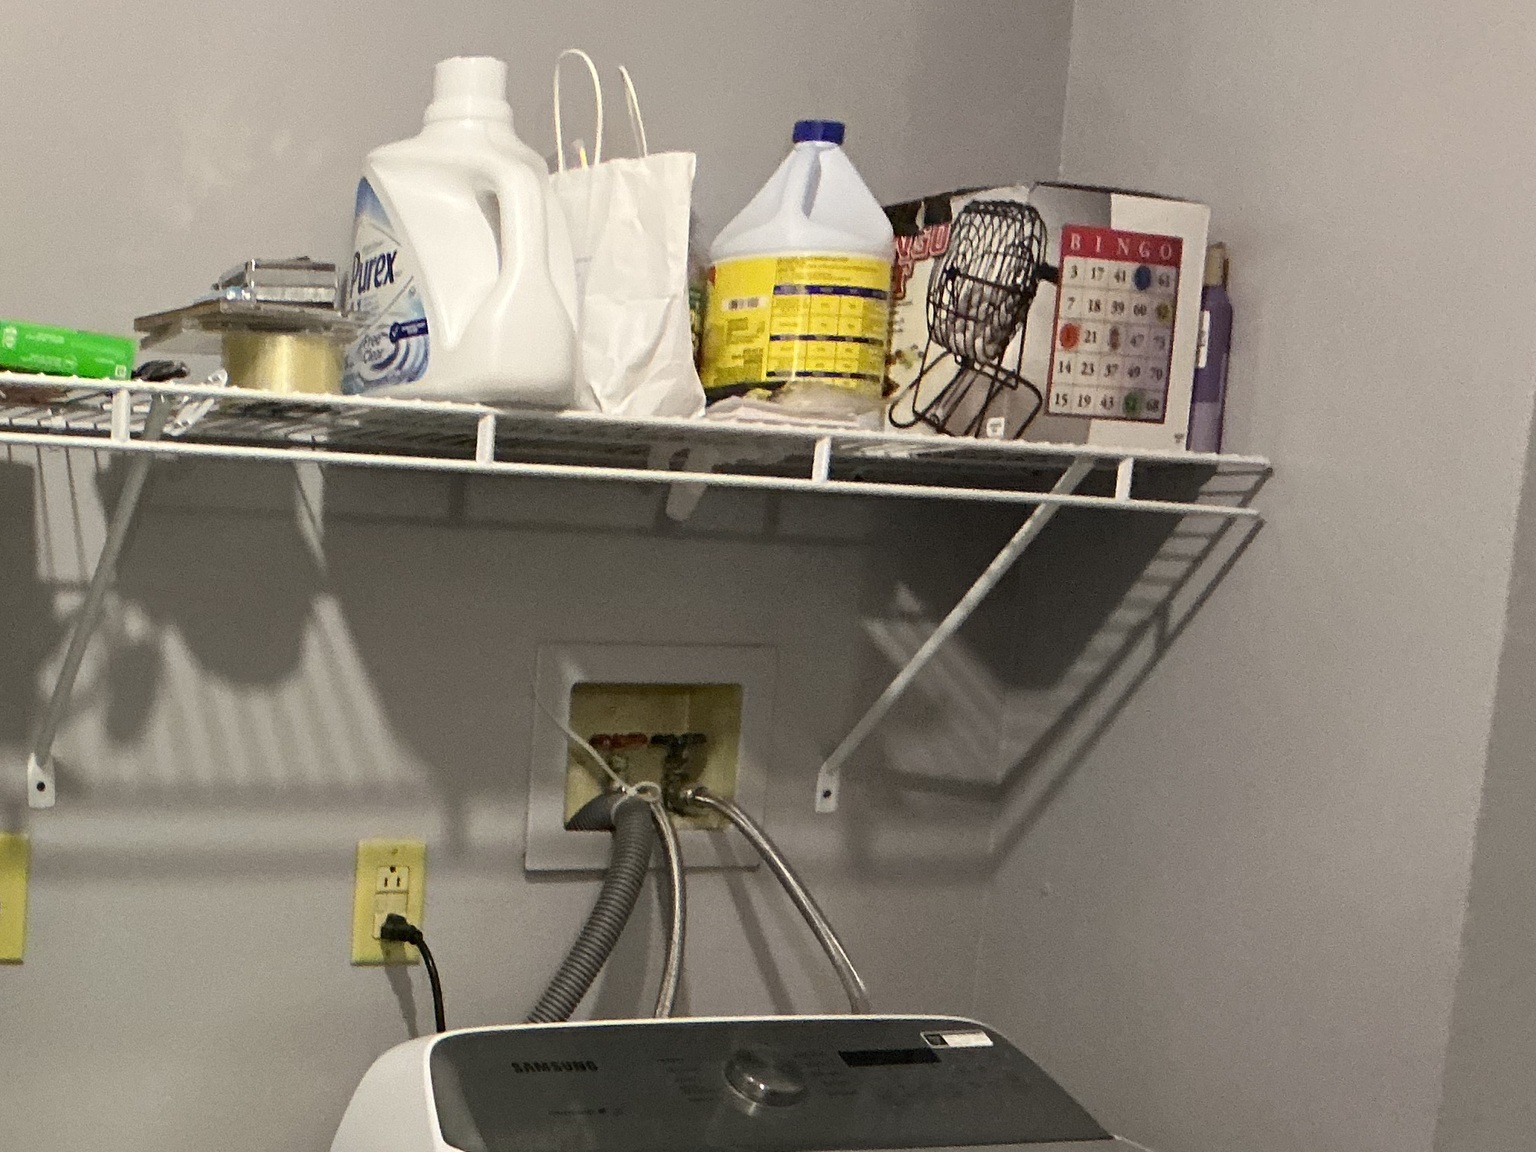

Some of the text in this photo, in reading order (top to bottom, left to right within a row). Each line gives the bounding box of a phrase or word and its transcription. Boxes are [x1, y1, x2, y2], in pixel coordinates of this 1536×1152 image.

[350, 251, 398, 299] Purex
[1070, 265, 1078, 280] 3
[1091, 266, 1105, 281] 17
[1067, 297, 1075, 311] 7
[1088, 299, 1101, 313] 18
[1084, 330, 1097, 343] 21
[1058, 361, 1071, 374] 14
[1055, 393, 1068, 407] 15
[1078, 394, 1092, 408] 19
[511, 1060, 599, 1073] SAMSUNG
